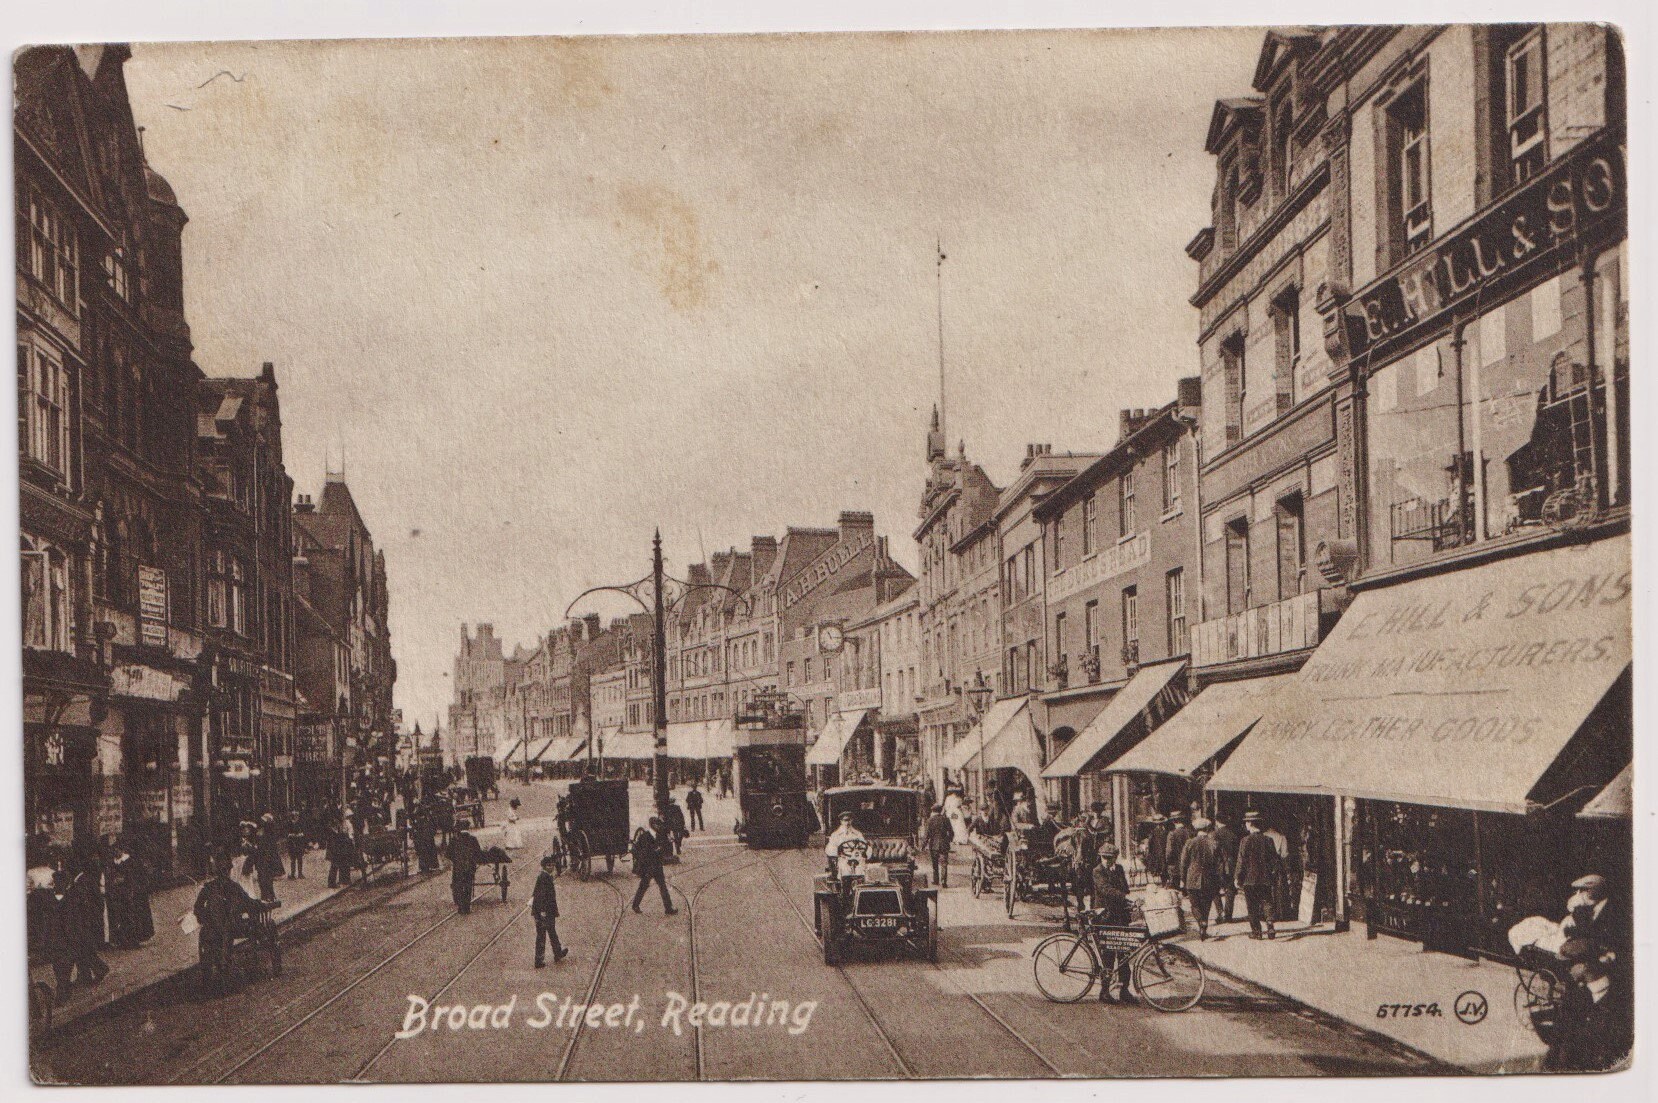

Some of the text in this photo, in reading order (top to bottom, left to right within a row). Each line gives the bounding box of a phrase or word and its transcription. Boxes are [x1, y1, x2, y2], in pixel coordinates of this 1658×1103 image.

[1399, 237, 1505, 322] HILL
[1511, 215, 1537, 259] &
[1377, 600, 1452, 637] HILL
[1462, 591, 1494, 623] &
[1504, 572, 1631, 619] SONS
[1431, 715, 1543, 745] GOODS
